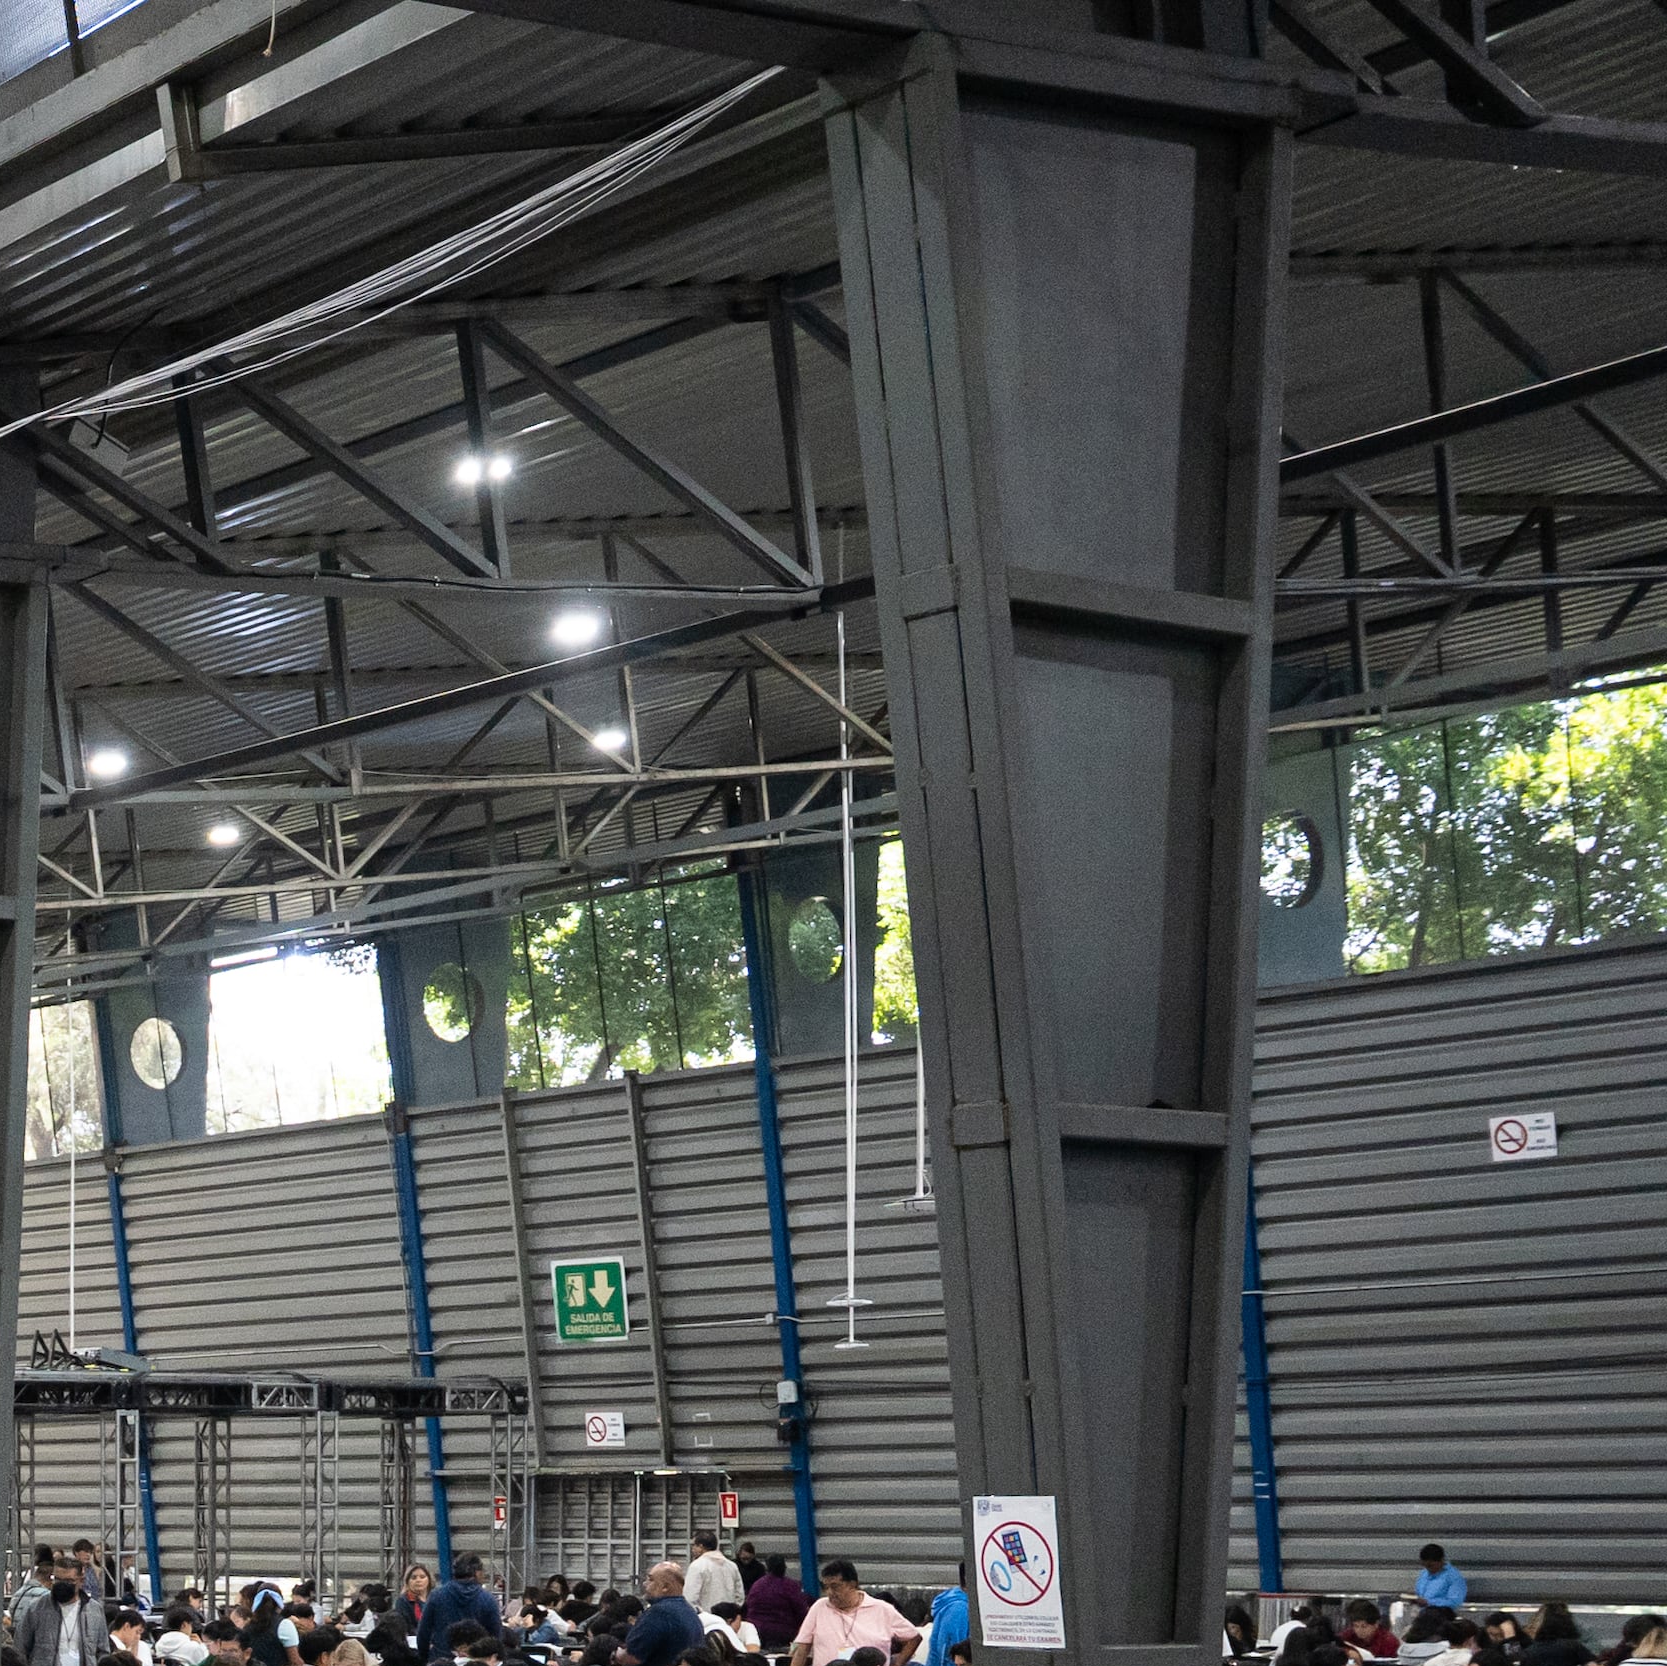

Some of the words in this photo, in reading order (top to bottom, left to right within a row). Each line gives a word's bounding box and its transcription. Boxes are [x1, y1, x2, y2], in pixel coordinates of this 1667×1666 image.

[570, 1313, 601, 1323] SALIDA
[602, 1312, 615, 1322] DE
[565, 1324, 622, 1335] EMERGENCIA
